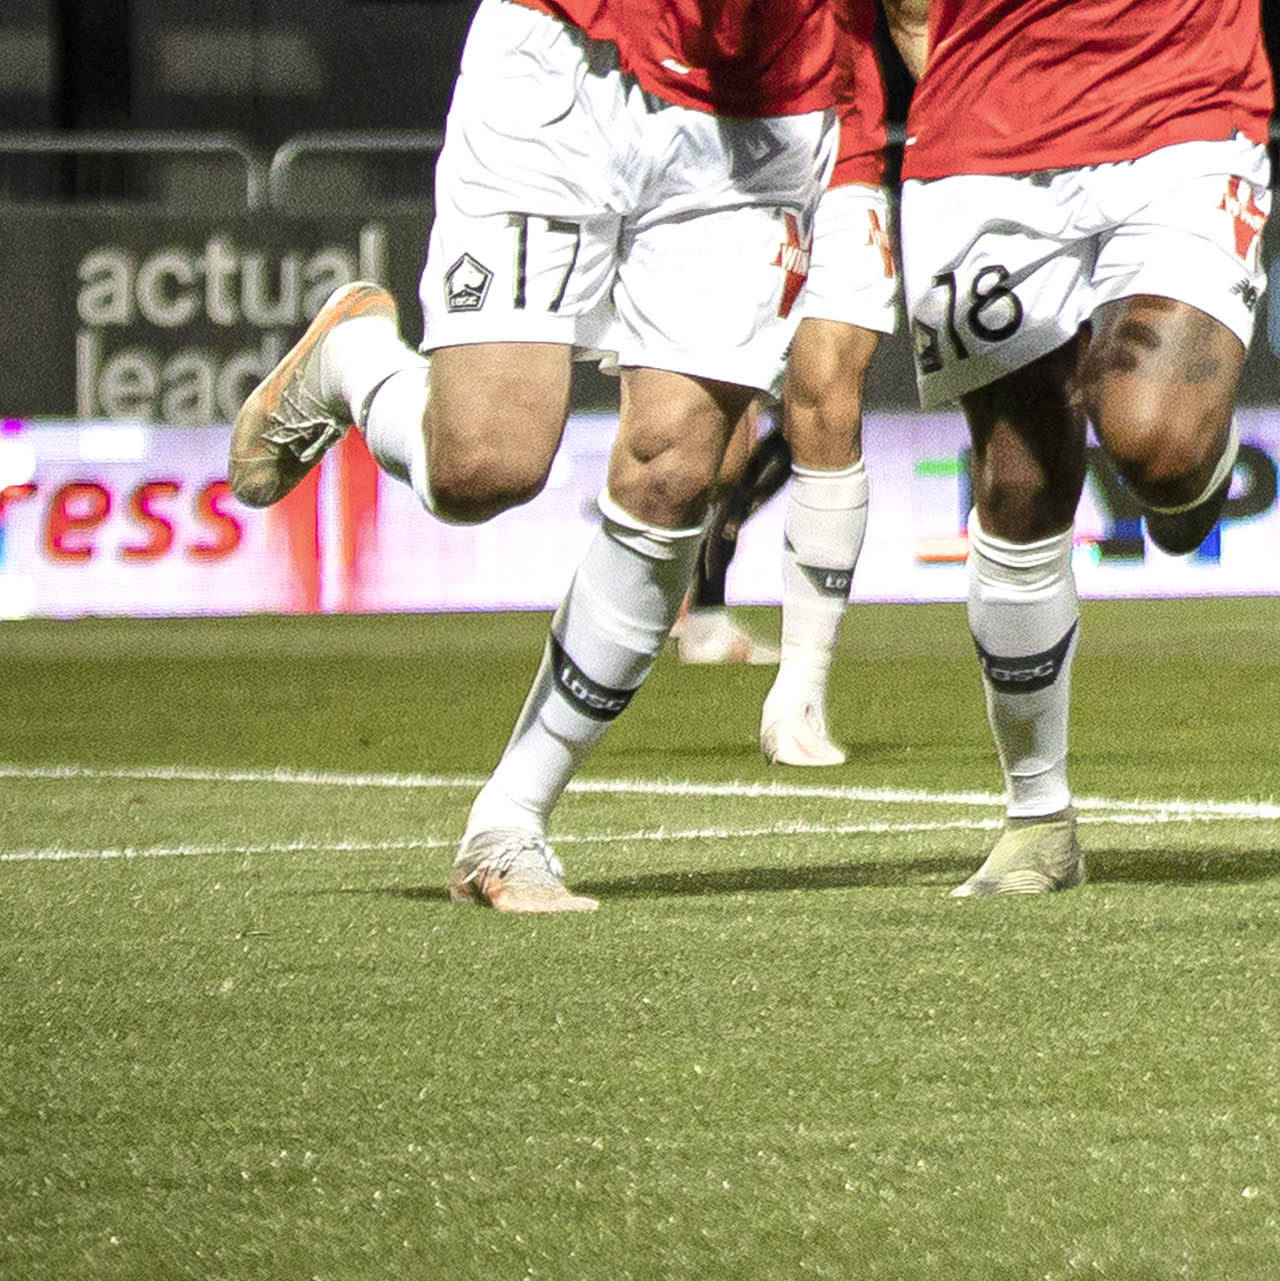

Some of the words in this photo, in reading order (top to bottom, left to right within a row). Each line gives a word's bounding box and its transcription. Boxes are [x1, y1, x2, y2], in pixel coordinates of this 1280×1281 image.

[76, 223, 388, 327] actual
[503, 211, 581, 312] 17
[932, 265, 1023, 360] 18
